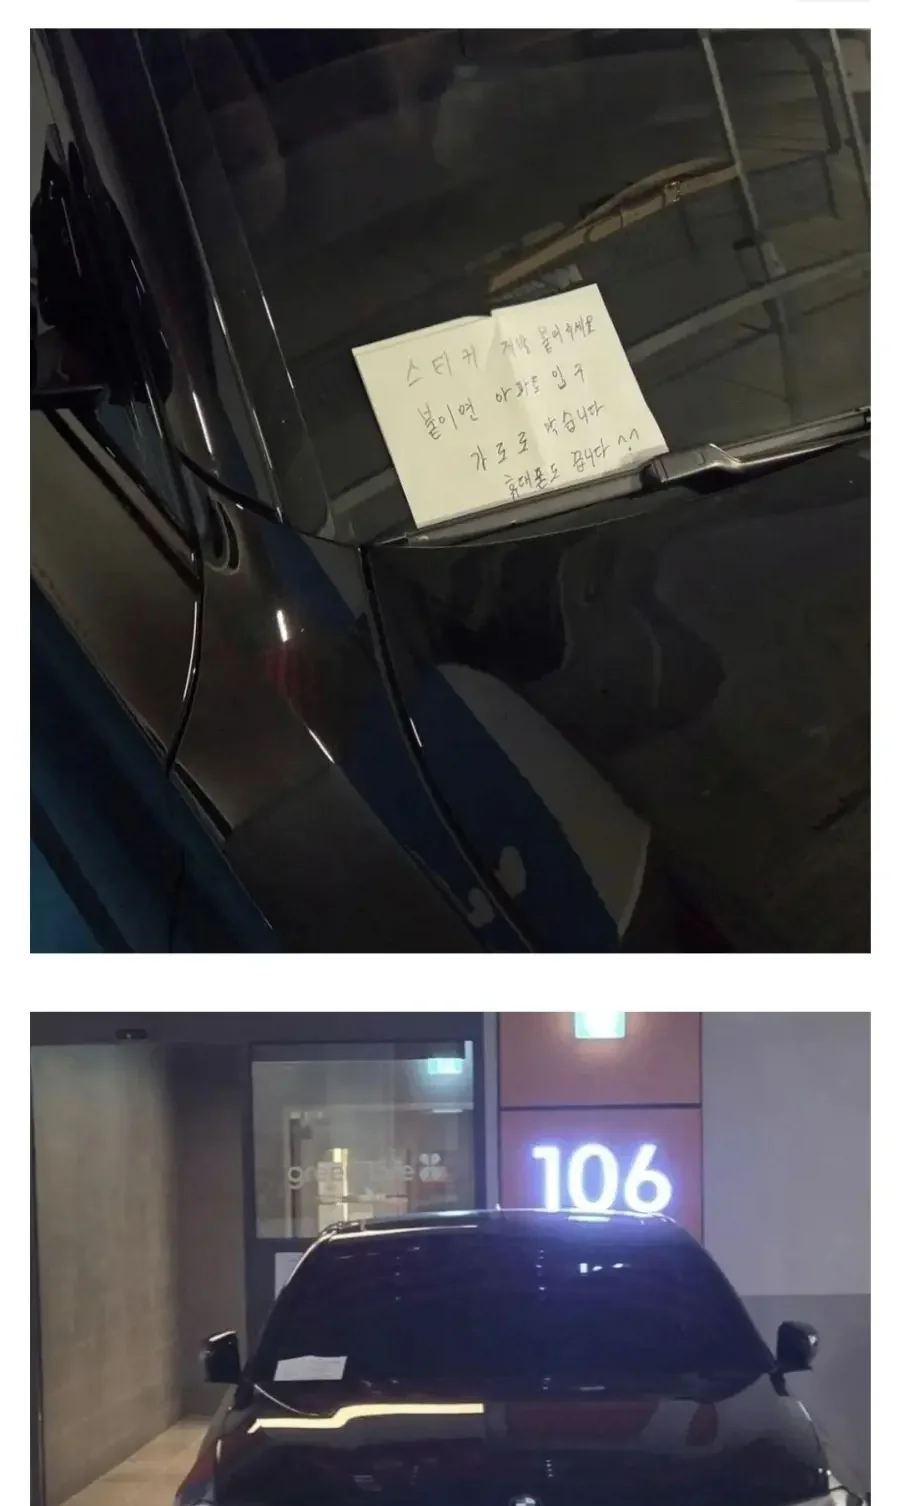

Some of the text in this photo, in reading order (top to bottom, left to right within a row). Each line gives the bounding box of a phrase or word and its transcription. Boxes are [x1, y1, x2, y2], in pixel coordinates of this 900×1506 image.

[407, 344, 479, 387] 스티커
[417, 362, 585, 440] 붙이면 아파트 입구
[470, 400, 605, 471] 가로로 막습니다
[504, 463, 560, 500] 휴대폰도
[571, 437, 611, 473] 끕니다
[532, 1143, 673, 1215] 106
